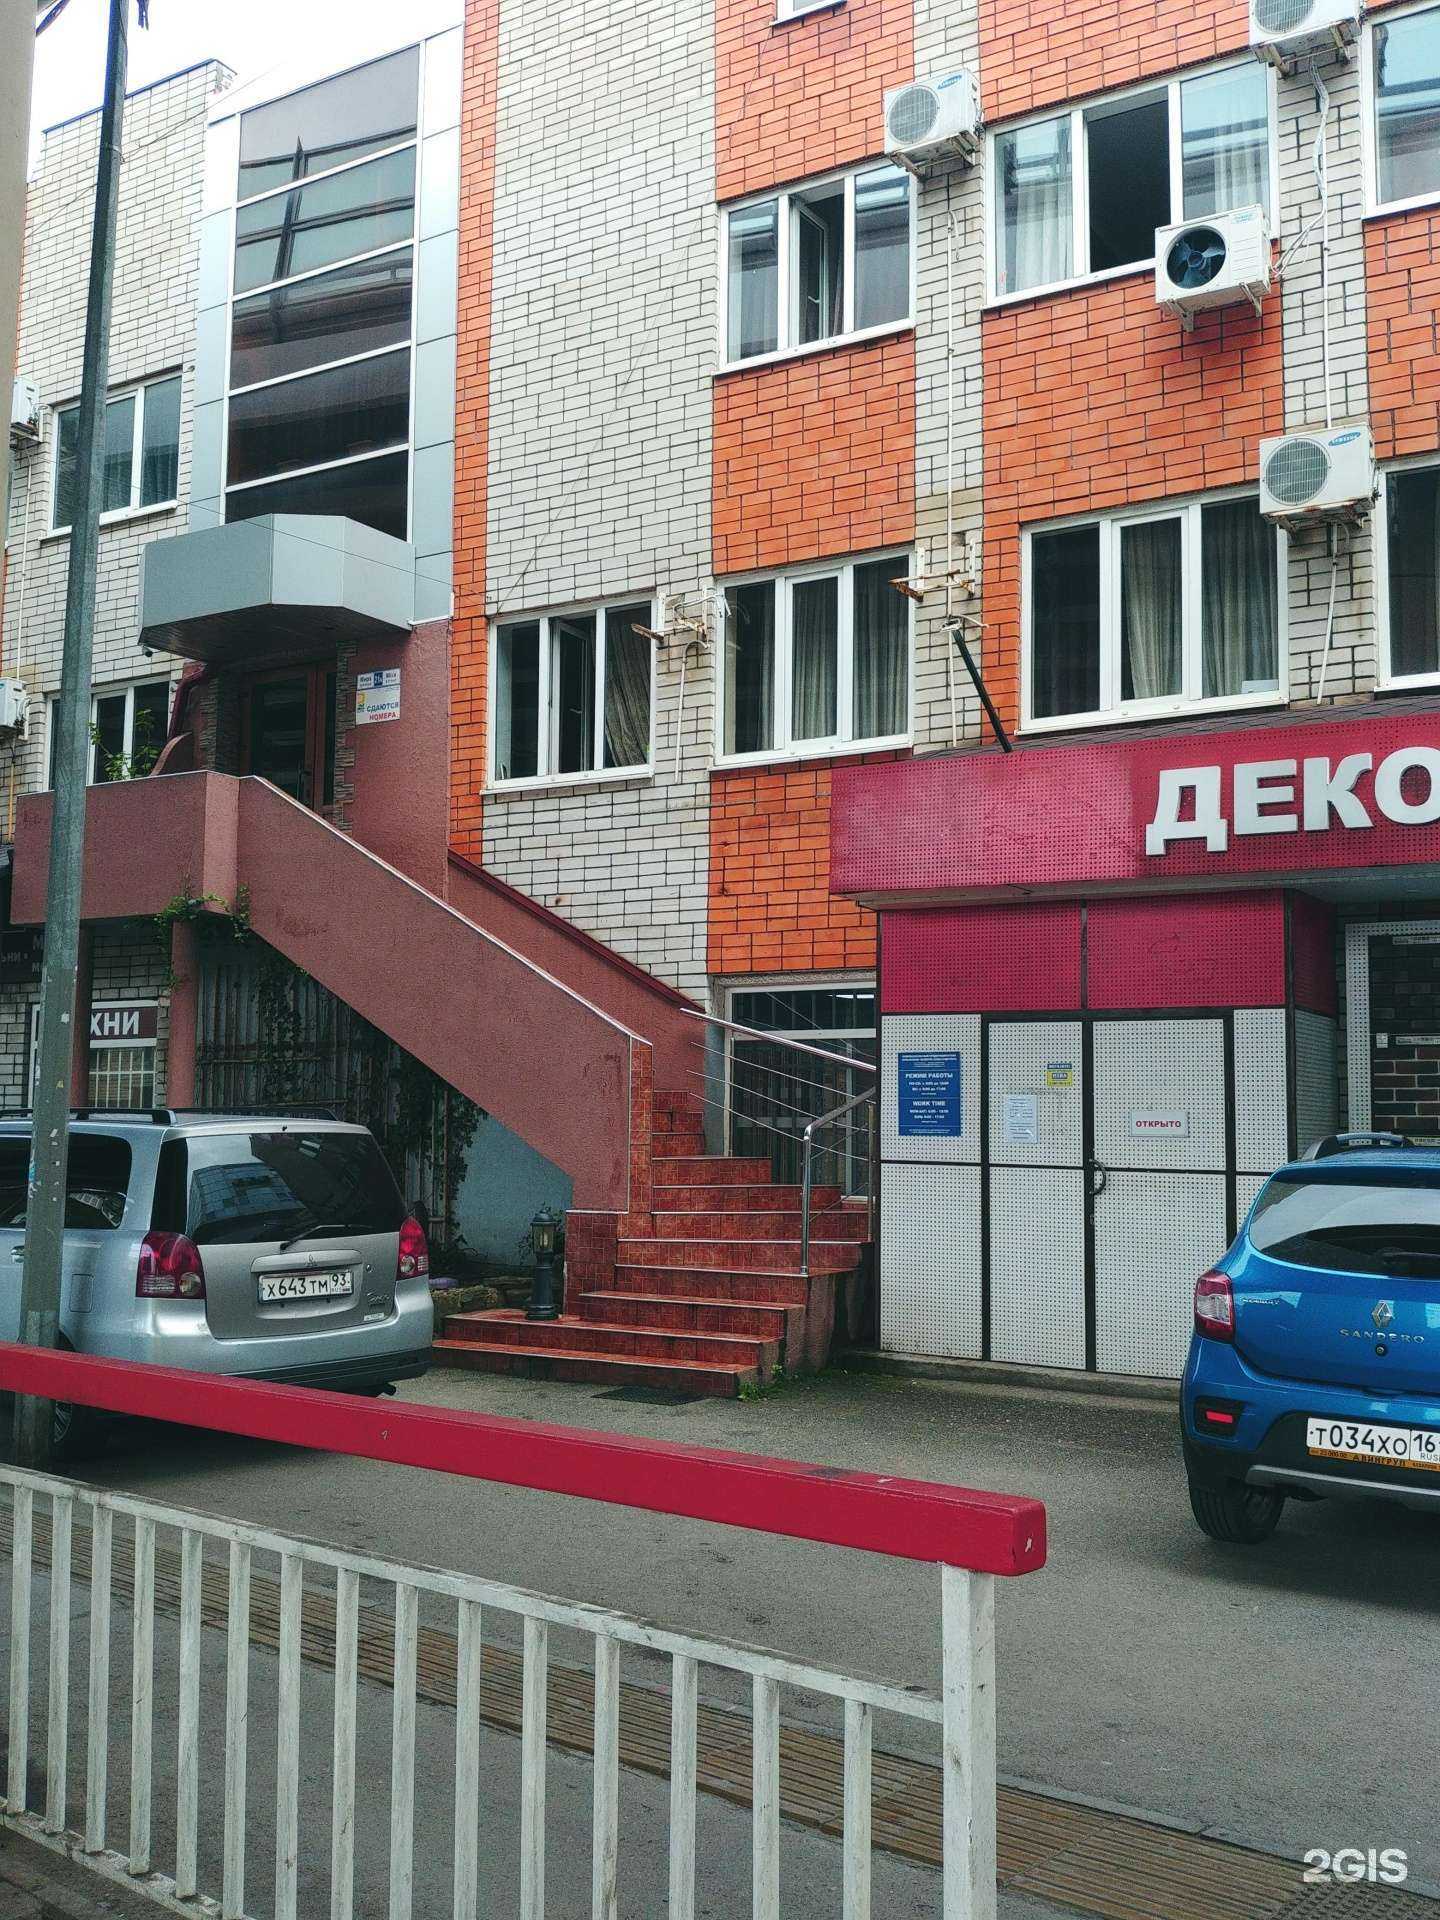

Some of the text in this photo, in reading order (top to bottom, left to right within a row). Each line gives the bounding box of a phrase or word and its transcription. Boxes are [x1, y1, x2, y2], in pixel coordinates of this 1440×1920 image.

[369, 712, 396, 720] НОМЕРА
[1145, 746, 1440, 856] ДЕКО
[1135, 1120, 1182, 1128] ОТКРЫТО
[1339, 1328, 1425, 1344] SANDERO
